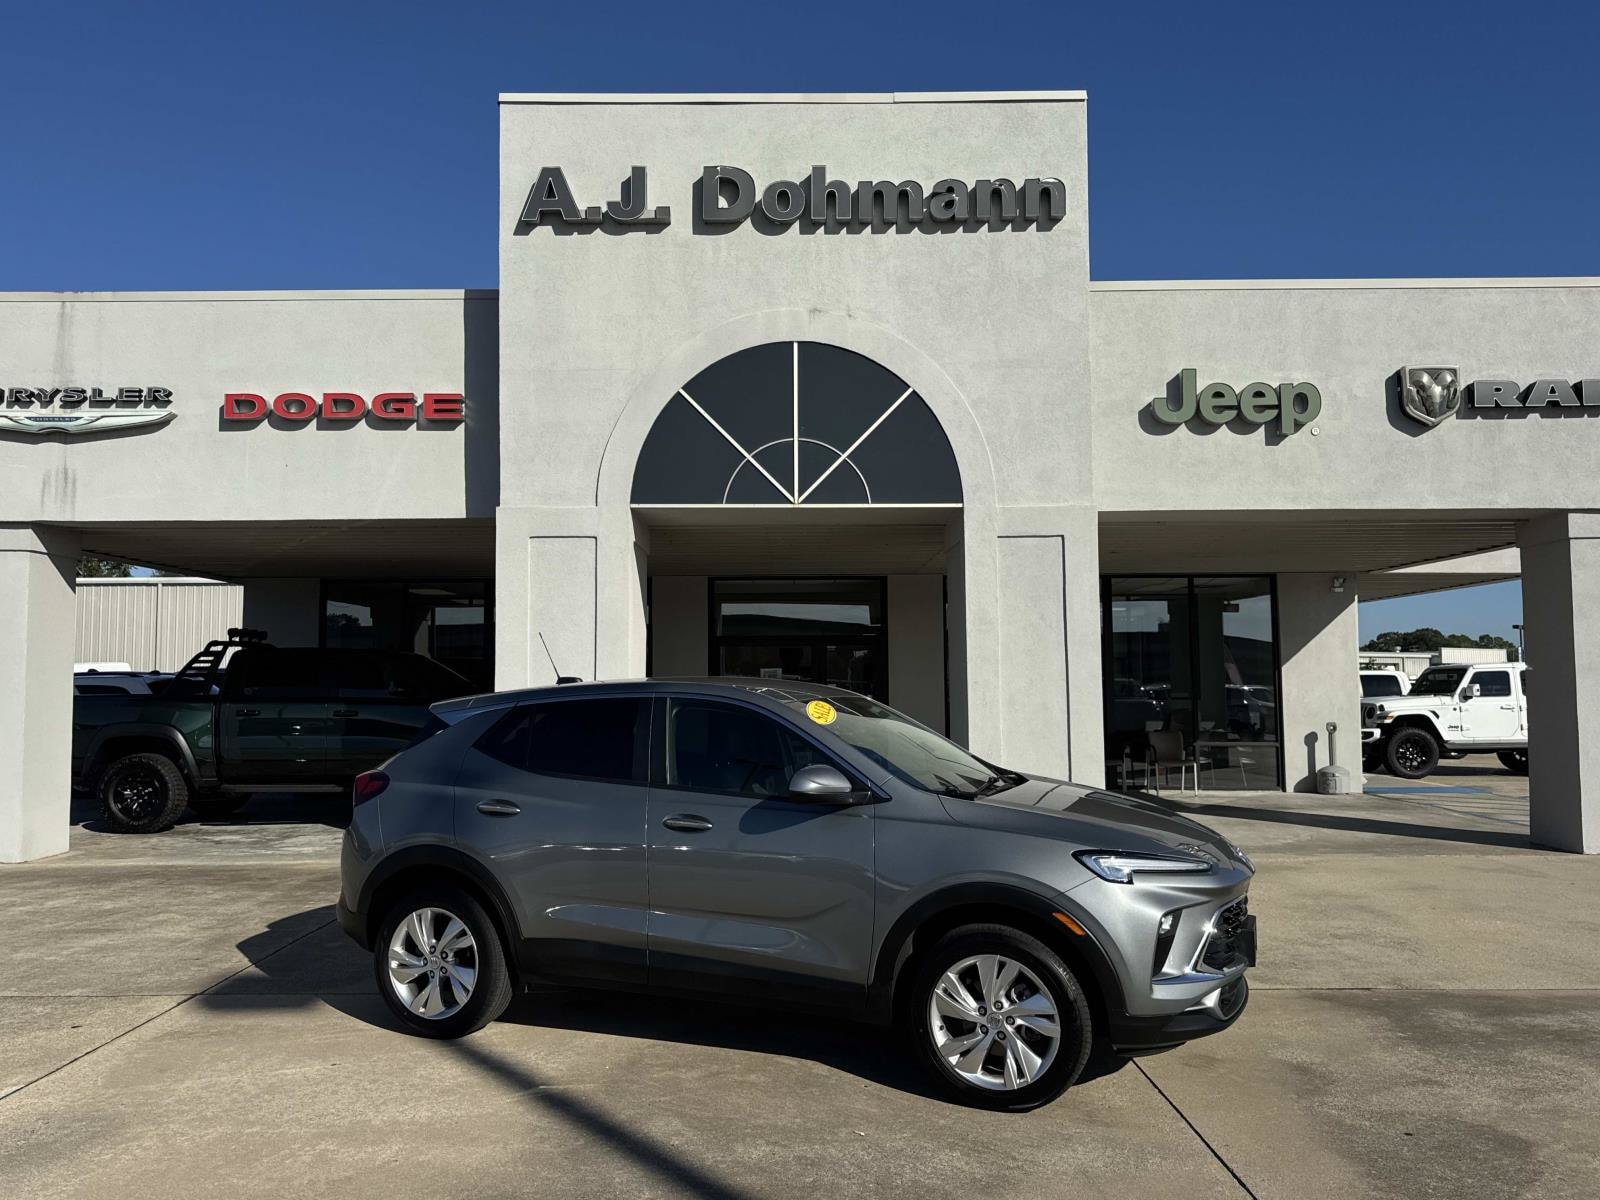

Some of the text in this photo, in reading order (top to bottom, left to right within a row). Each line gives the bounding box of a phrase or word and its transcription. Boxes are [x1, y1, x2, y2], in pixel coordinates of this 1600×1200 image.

[520, 164, 1067, 226] A.J. Dohmann
[0, 386, 173, 402] RYSLER
[223, 393, 464, 420] DODGE
[1152, 368, 1322, 434] Jeep
[1473, 379, 1600, 407] RA
